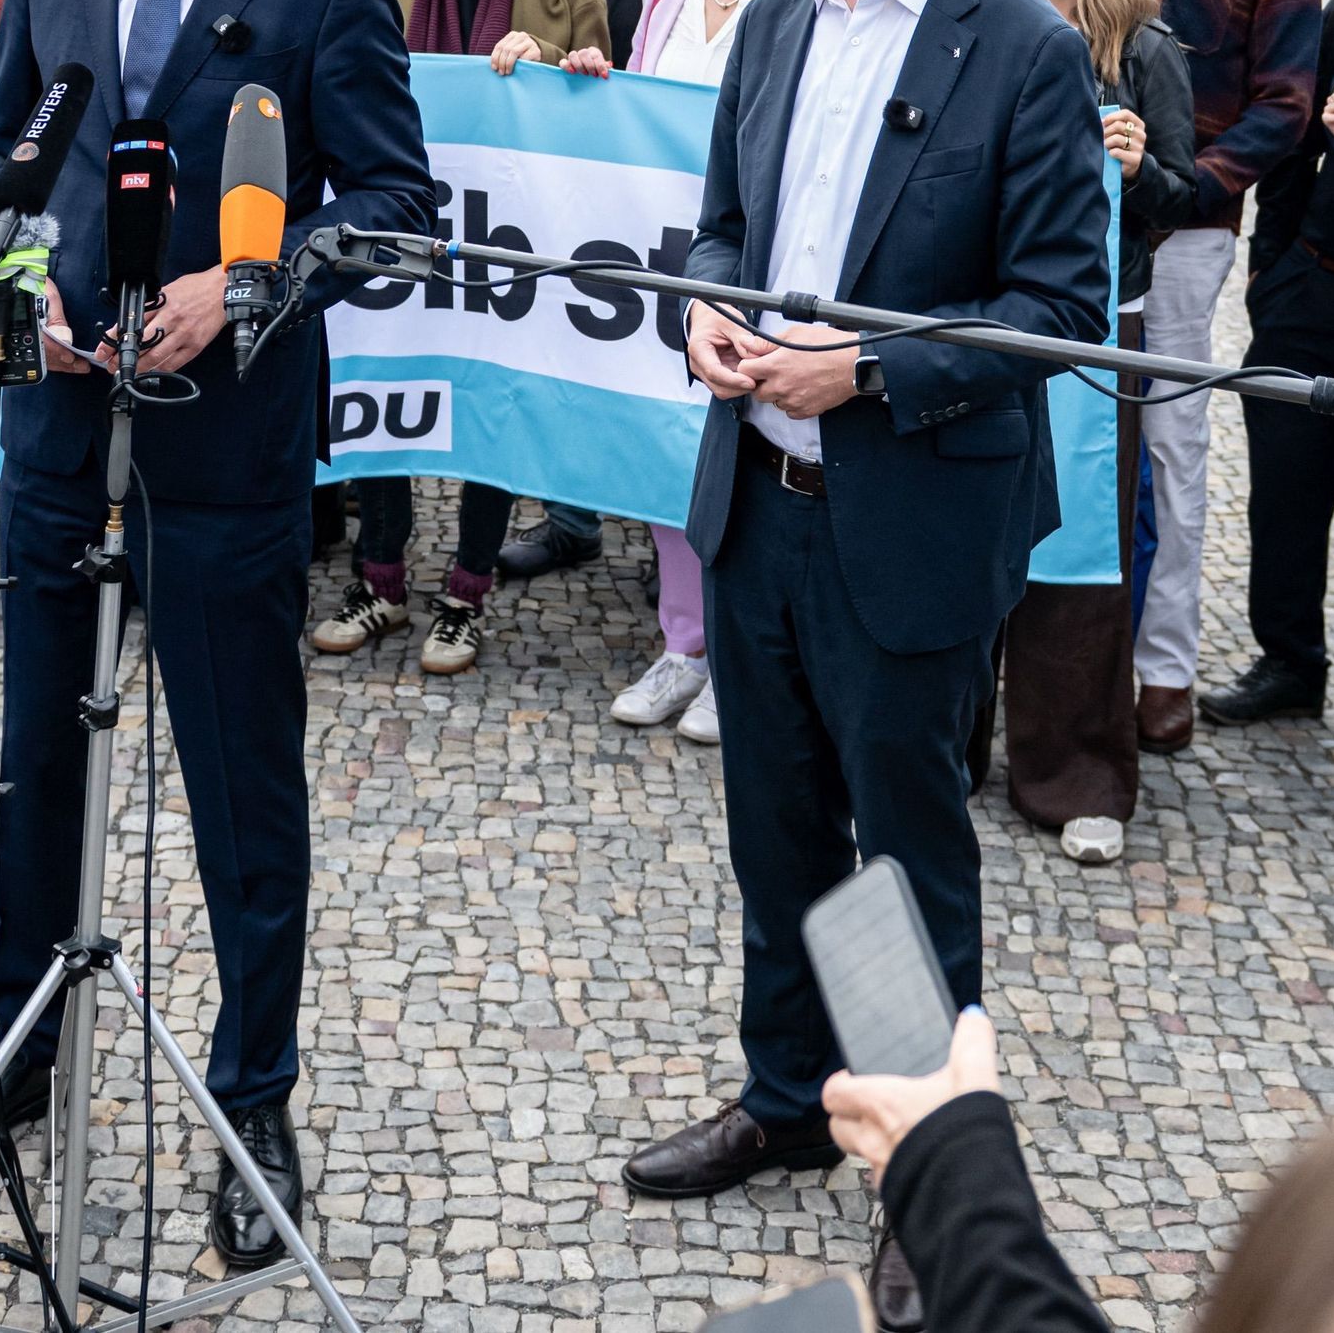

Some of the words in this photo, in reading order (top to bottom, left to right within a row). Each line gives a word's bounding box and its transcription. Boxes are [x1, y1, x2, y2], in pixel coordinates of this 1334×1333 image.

[26, 83, 68, 138] REUTERS
[125, 175, 147, 185] ntv
[224, 288, 252, 301] ZDF
[330, 390, 441, 444] DU
